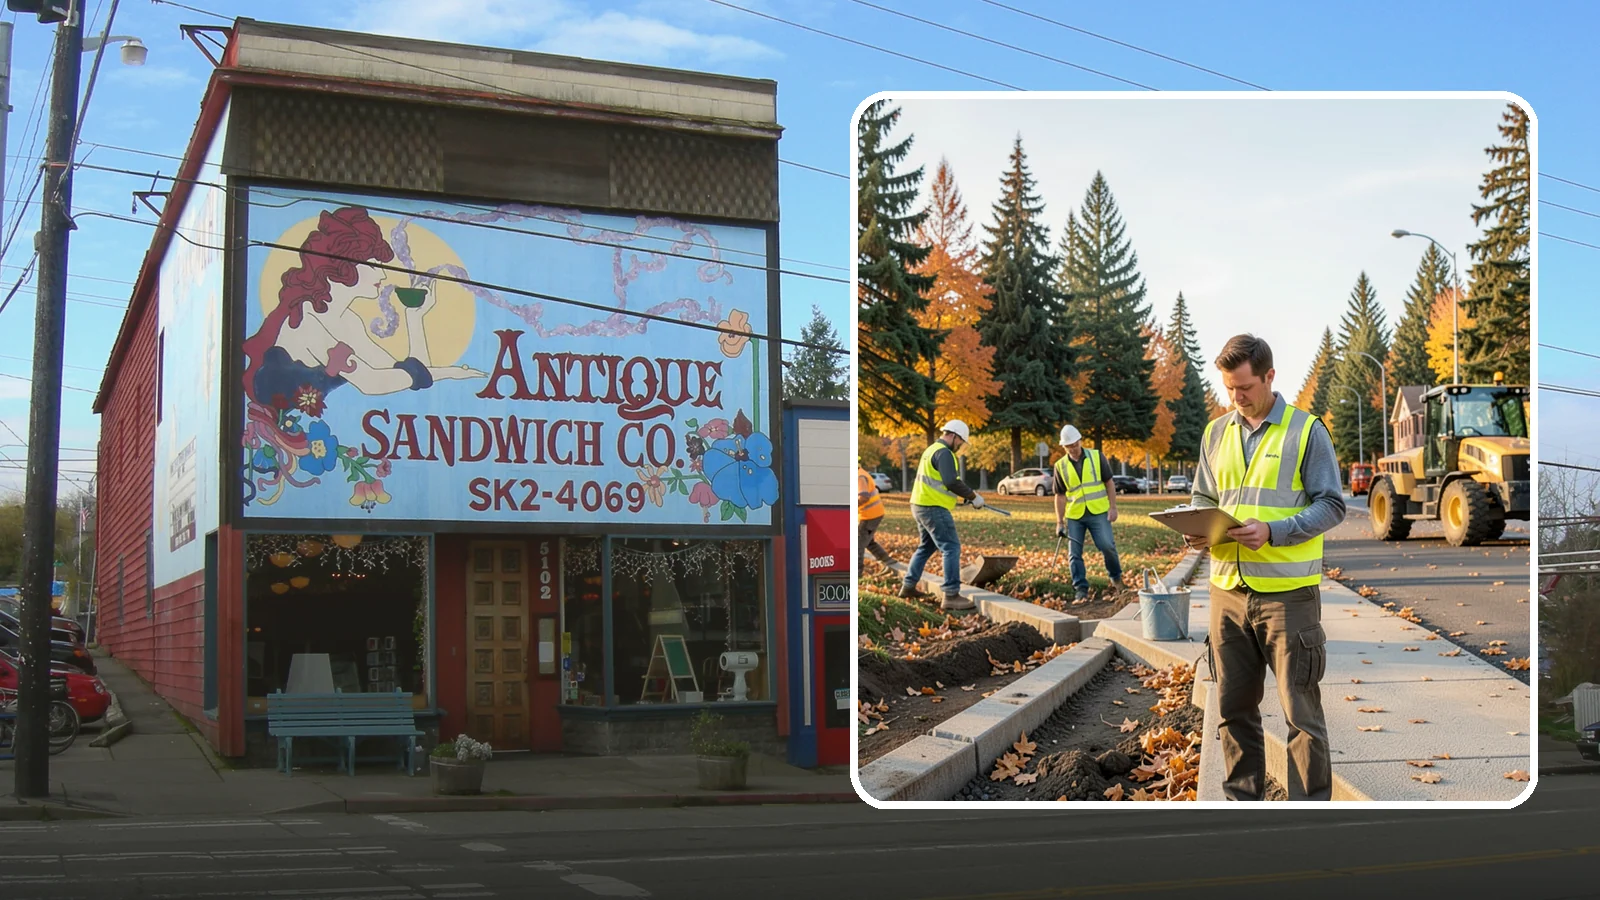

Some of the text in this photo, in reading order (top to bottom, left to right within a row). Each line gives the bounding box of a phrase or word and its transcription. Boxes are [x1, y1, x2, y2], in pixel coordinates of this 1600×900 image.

[476, 328, 723, 420] ANTIQUE
[361, 408, 685, 470] SANDWICH CO.
[468, 477, 646, 513] SK2-4069
[540, 541, 551, 600] 5102
[809, 555, 835, 569] BOOKS
